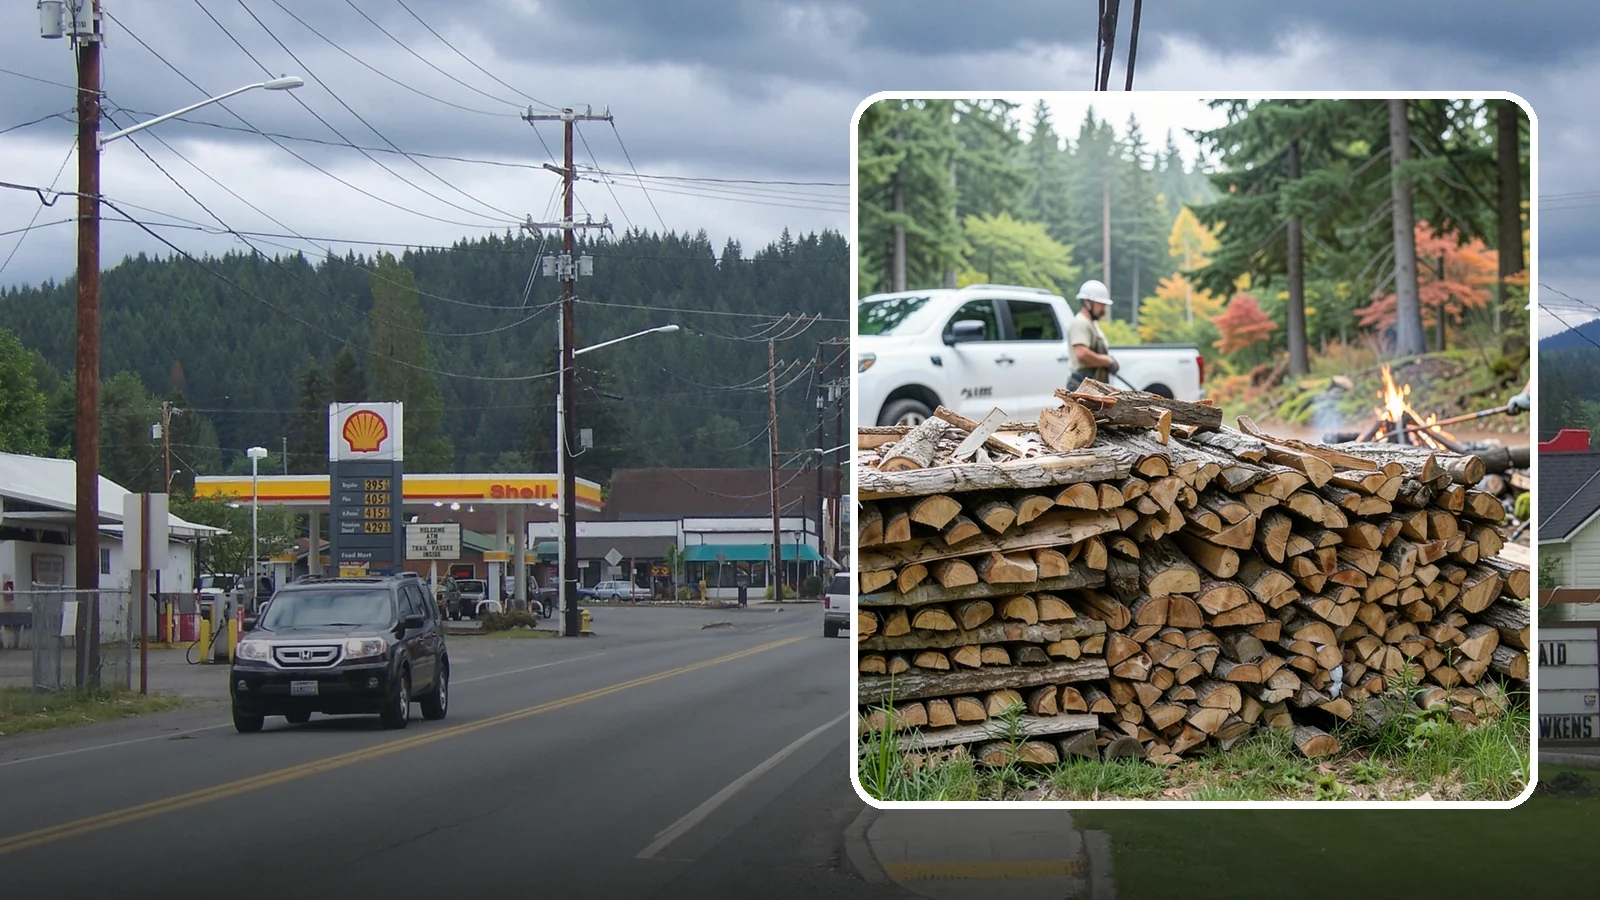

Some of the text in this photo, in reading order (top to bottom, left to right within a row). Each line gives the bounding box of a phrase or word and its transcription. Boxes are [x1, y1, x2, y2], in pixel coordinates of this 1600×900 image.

[366, 480, 384, 490] 395
[490, 484, 547, 499] Shell
[366, 494, 384, 504] 405
[365, 508, 383, 518] 415
[366, 522, 384, 533] 429
